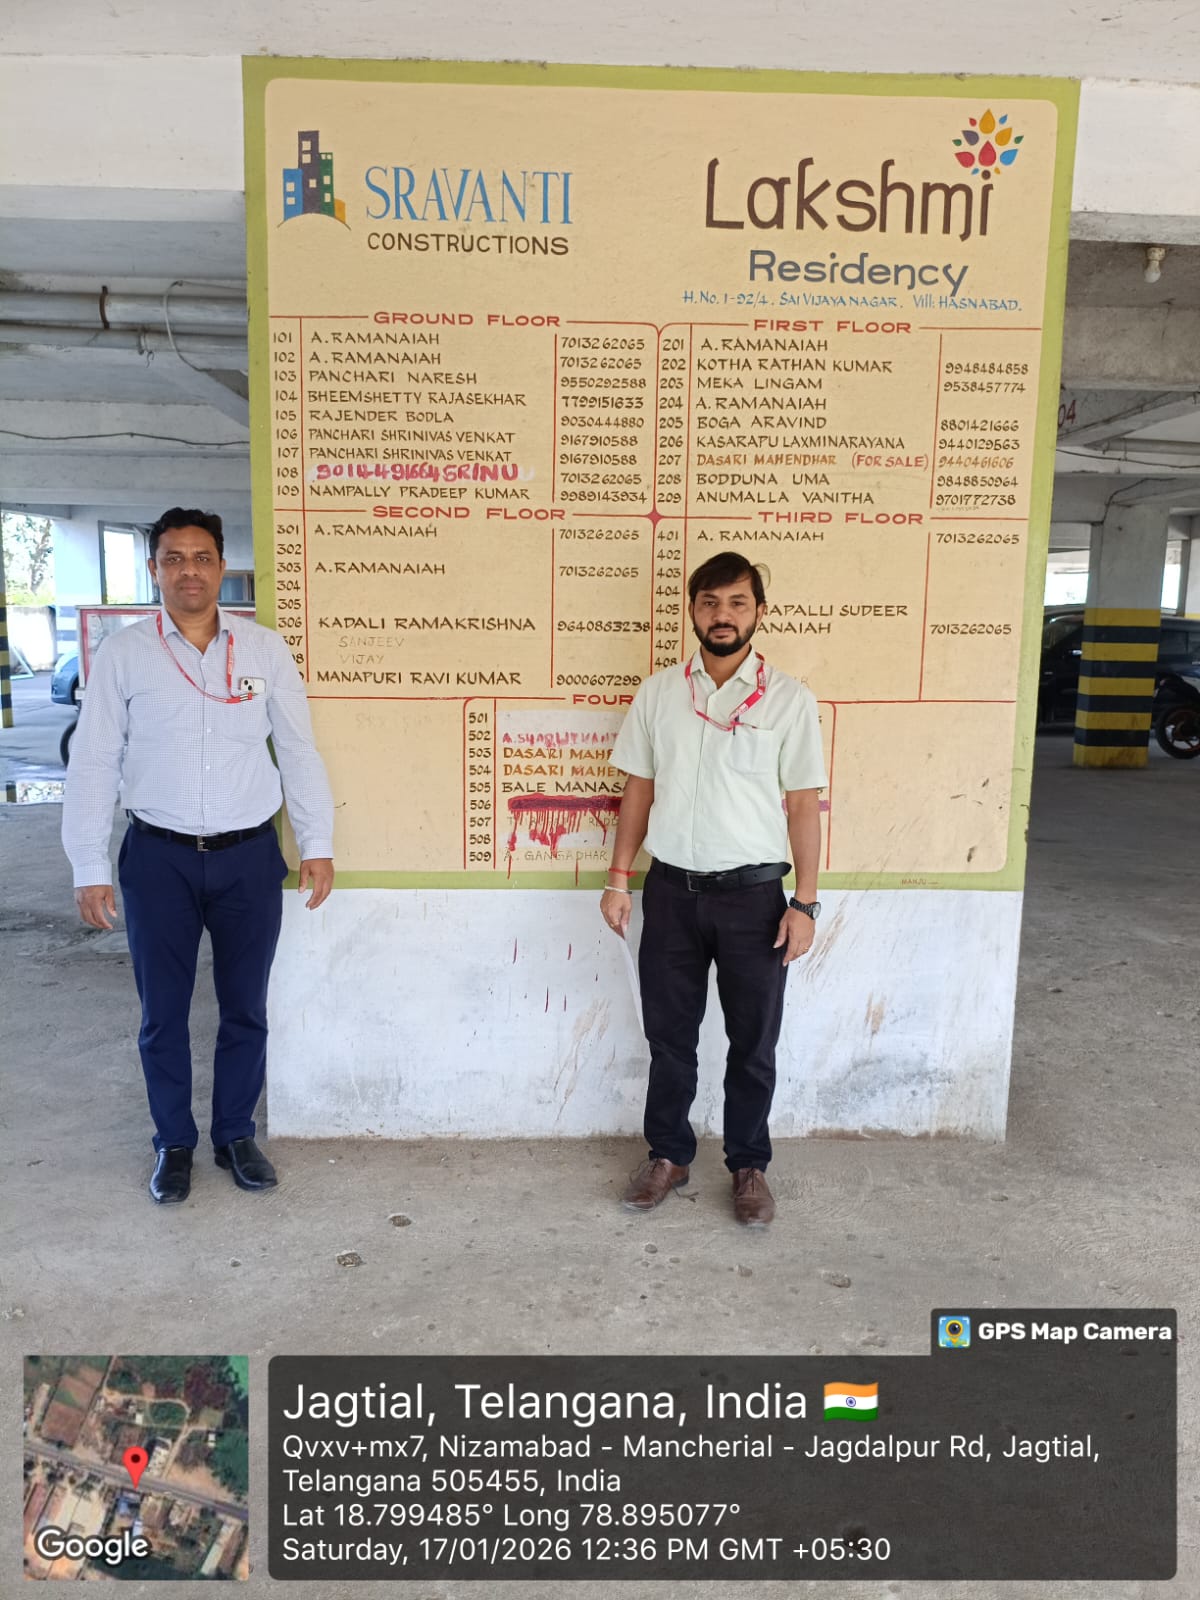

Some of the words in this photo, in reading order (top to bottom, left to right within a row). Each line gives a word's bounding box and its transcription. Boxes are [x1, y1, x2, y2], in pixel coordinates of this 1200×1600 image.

[365, 166, 573, 224] SRAVANTI
[705, 157, 994, 242] Lakshmi
[367, 232, 569, 255] CONSTRUCTIONS
[749, 249, 968, 297] Residency
[939, 296, 1022, 311] HASNABAD.
[374, 312, 473, 325] GROUND
[488, 315, 560, 327] FLOOR
[754, 319, 823, 331] FIRST
[837, 321, 911, 333] FLOOR
[273, 332, 292, 343] 101
[663, 339, 684, 351] 201
[274, 352, 295, 363] 102
[662, 358, 686, 371] 202
[698, 358, 752, 371] KOTHA
[758, 358, 825, 371] RATHAN
[833, 360, 892, 373] KUMAR
[945, 362, 1028, 375] 9948484858
[274, 371, 296, 382] 103
[309, 370, 394, 383] PANCHARI
[408, 372, 477, 384] NARESH
[561, 376, 646, 389] 9550292588
[660, 378, 683, 389] 203
[698, 377, 743, 389] MEKA
[754, 378, 822, 389] LINGAM
[944, 381, 1026, 392] 9538457774
[275, 390, 297, 401] 104
[308, 390, 422, 403] BHEEMSHETTY
[428, 392, 526, 406] RAJASEKHAR
[562, 396, 644, 409] 7799151633
[659, 396, 683, 409] 204
[275, 410, 296, 421] 105
[309, 410, 398, 421] RAJENDER
[406, 411, 454, 423] BODLA
[561, 416, 644, 428] 9030444880
[659, 417, 683, 428] 205
[697, 416, 741, 428] BOGA
[751, 416, 827, 428] ARAVIND
[941, 420, 1019, 432] 8801421666
[277, 429, 297, 440] 106
[309, 428, 374, 441] PANCHARI
[381, 430, 452, 442] SHRINIVAS
[456, 432, 515, 443] VENKAT
[561, 434, 638, 446] 9167910588
[660, 436, 683, 448] 206
[697, 435, 779, 448] KASARAPU
[783, 436, 904, 449] LAXMINARAYANA
[278, 448, 299, 458] 107
[310, 448, 378, 459] PANCHARI
[382, 449, 453, 460] SHRINIVAS
[458, 450, 512, 462] VENKAT
[560, 453, 637, 465] 9167910588
[659, 455, 681, 466] 207
[697, 453, 746, 466] DASARI
[754, 454, 837, 466] MAHENDHAR
[852, 452, 881, 469] (FOR
[885, 454, 929, 471] SALE)
[277, 467, 298, 478] 108
[658, 474, 681, 485] 208
[696, 473, 778, 485] BODDUNA
[793, 473, 830, 485] UMA
[278, 485, 299, 496] 109
[310, 485, 390, 497] NAMPALLY
[400, 486, 467, 499] PRADEEP
[475, 488, 529, 499] KUMAR
[560, 491, 647, 503] 9989143934
[657, 493, 681, 503] 209
[696, 491, 789, 503] ANUMALLA
[802, 492, 874, 505] VANITHA
[936, 494, 1016, 506] 9701772738
[373, 506, 470, 518] SECOND
[487, 508, 565, 520] FLOOR
[758, 512, 832, 523] THIRD
[845, 513, 923, 525] FLOOR
[277, 525, 299, 535] 301
[560, 529, 639, 540] 7013262065
[658, 531, 678, 540] 401
[936, 533, 1020, 544] 7013262065
[277, 544, 301, 555] 302
[657, 550, 680, 560] 402
[277, 563, 301, 572] 303
[560, 566, 639, 578] 7013262065
[657, 568, 681, 578] 403
[277, 580, 300, 591] 304
[656, 586, 680, 597] 404
[278, 599, 301, 609] 305
[656, 604, 679, 615] 405
[764, 605, 832, 616] APALLI
[839, 605, 908, 616] SUDEER
[278, 617, 302, 628] 306
[319, 617, 385, 629] KADALI
[394, 617, 535, 631] RAMAKRISHNA
[656, 622, 679, 632] 406
[930, 624, 1012, 635] 7013262065
[656, 640, 679, 650] 407
[317, 671, 401, 683] MANAPURI
[410, 672, 449, 684] RAVI
[457, 672, 521, 685] KUMAR
[573, 694, 633, 705] FOUR
[469, 713, 488, 723] 501
[469, 731, 491, 741] 502
[469, 748, 491, 758] 503
[504, 748, 562, 759] DASARI
[469, 765, 491, 775] 504
[504, 764, 563, 776] DASARI
[571, 765, 628, 777] MAHEN
[470, 782, 491, 793] 505
[502, 782, 546, 793] BALE
[470, 800, 491, 810] 506
[470, 817, 492, 827] 507
[469, 834, 491, 844] 508
[469, 852, 491, 862] 509
